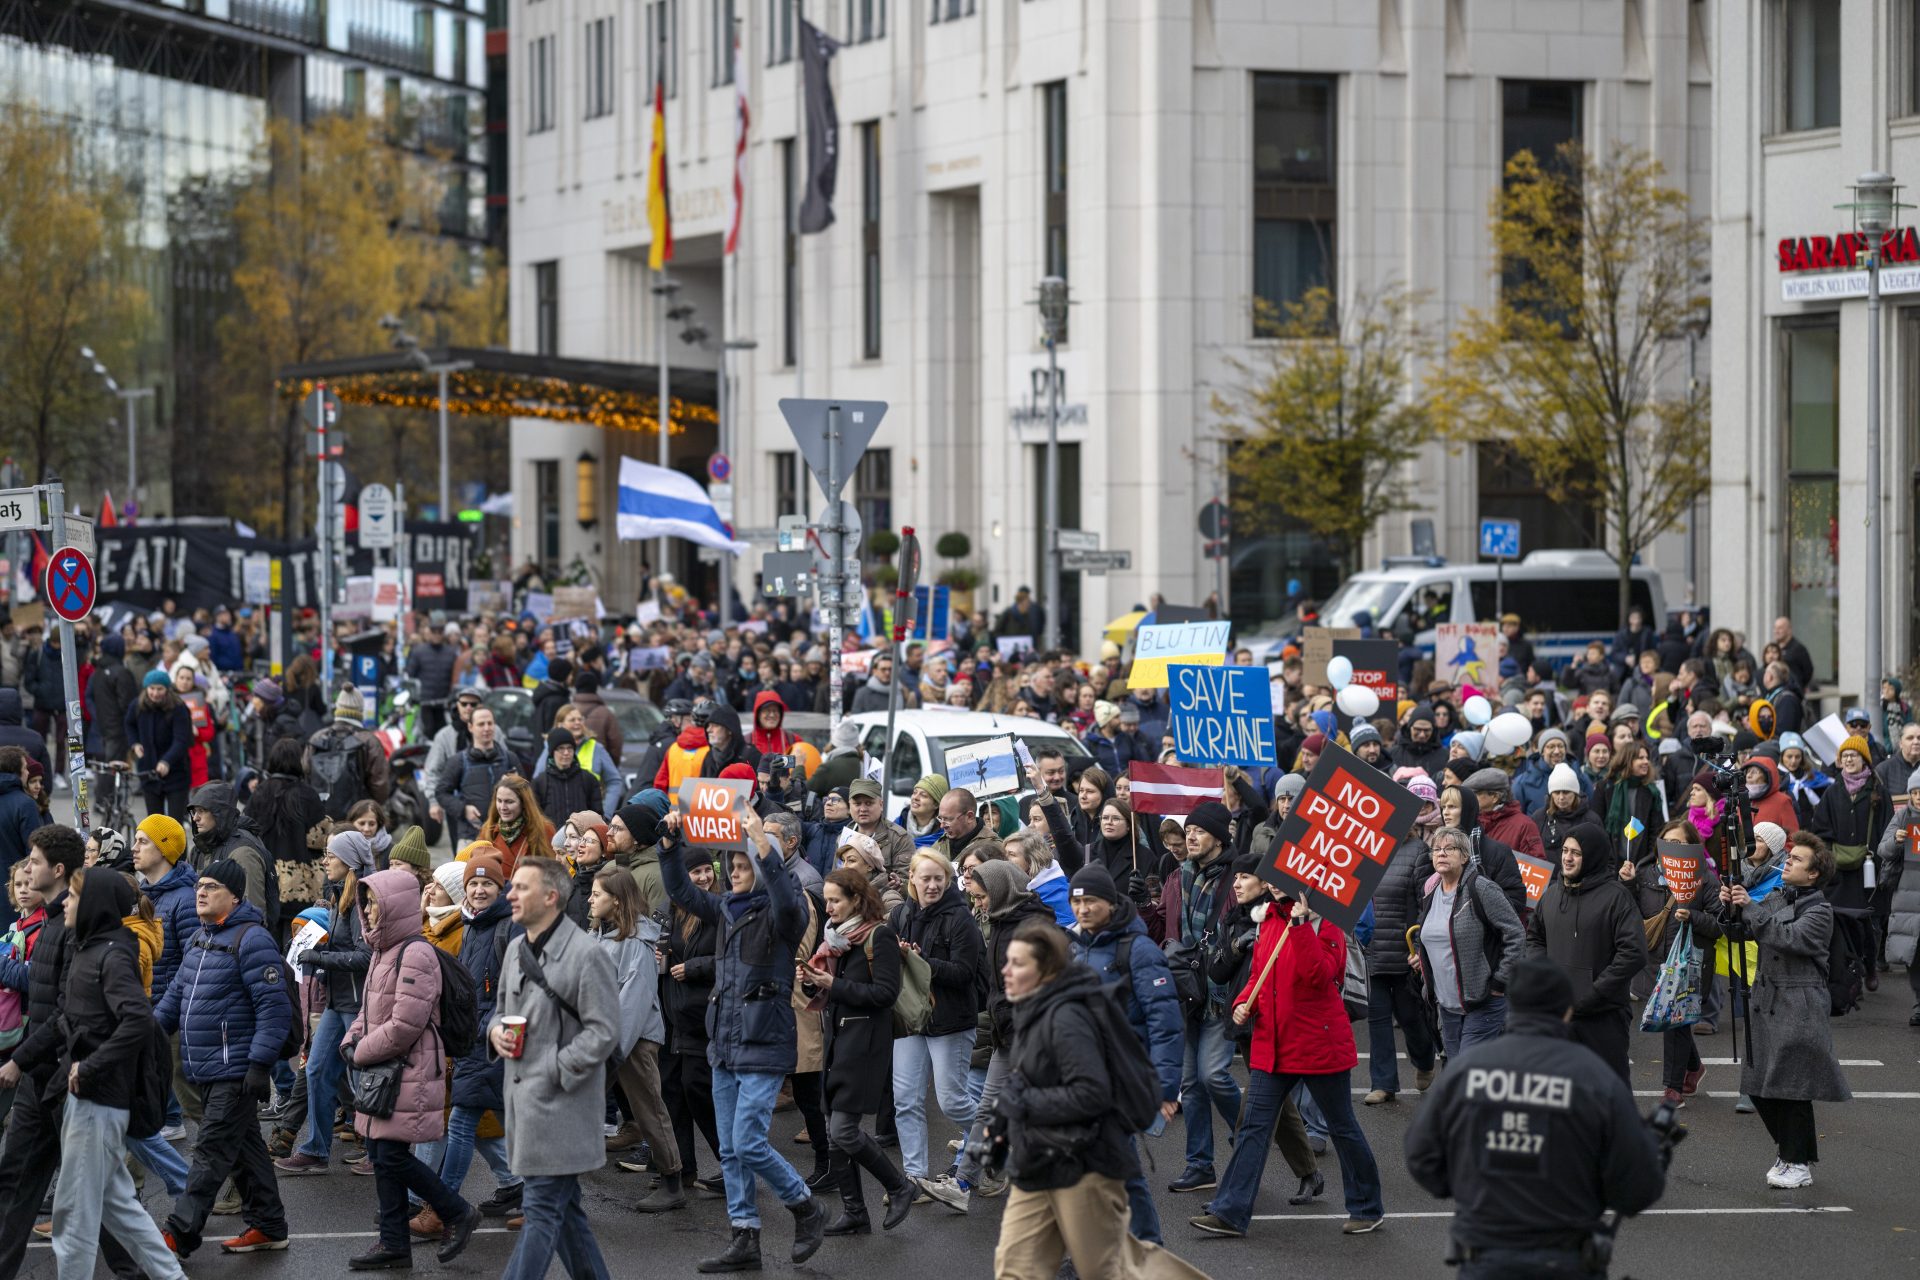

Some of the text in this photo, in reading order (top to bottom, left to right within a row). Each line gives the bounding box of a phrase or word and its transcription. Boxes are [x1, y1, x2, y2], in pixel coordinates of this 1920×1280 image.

[1778, 226, 1920, 272] SARAVNA
[0, 501, 21, 521] atz
[100, 537, 188, 594] EATH
[362, 656, 375, 676] P
[1350, 672, 1382, 684] STOP
[1179, 668, 1248, 715] SAVE
[1371, 687, 1394, 698] AR!
[1175, 714, 1274, 762] UKRAINE
[698, 788, 730, 812] NO
[1337, 781, 1380, 819] NO
[686, 815, 737, 840] WAR!
[1307, 795, 1385, 857] PUTIN
[1309, 830, 1353, 868] NO
[1286, 846, 1346, 898] WAR
[1663, 856, 1696, 869] NEIN ZU
[1665, 868, 1694, 879] PUTIN!
[1667, 879, 1678, 889] EIN
[1465, 1068, 1572, 1109] POLIZEI
[1501, 1111, 1529, 1133] BE
[1485, 1130, 1545, 1155] 11227
